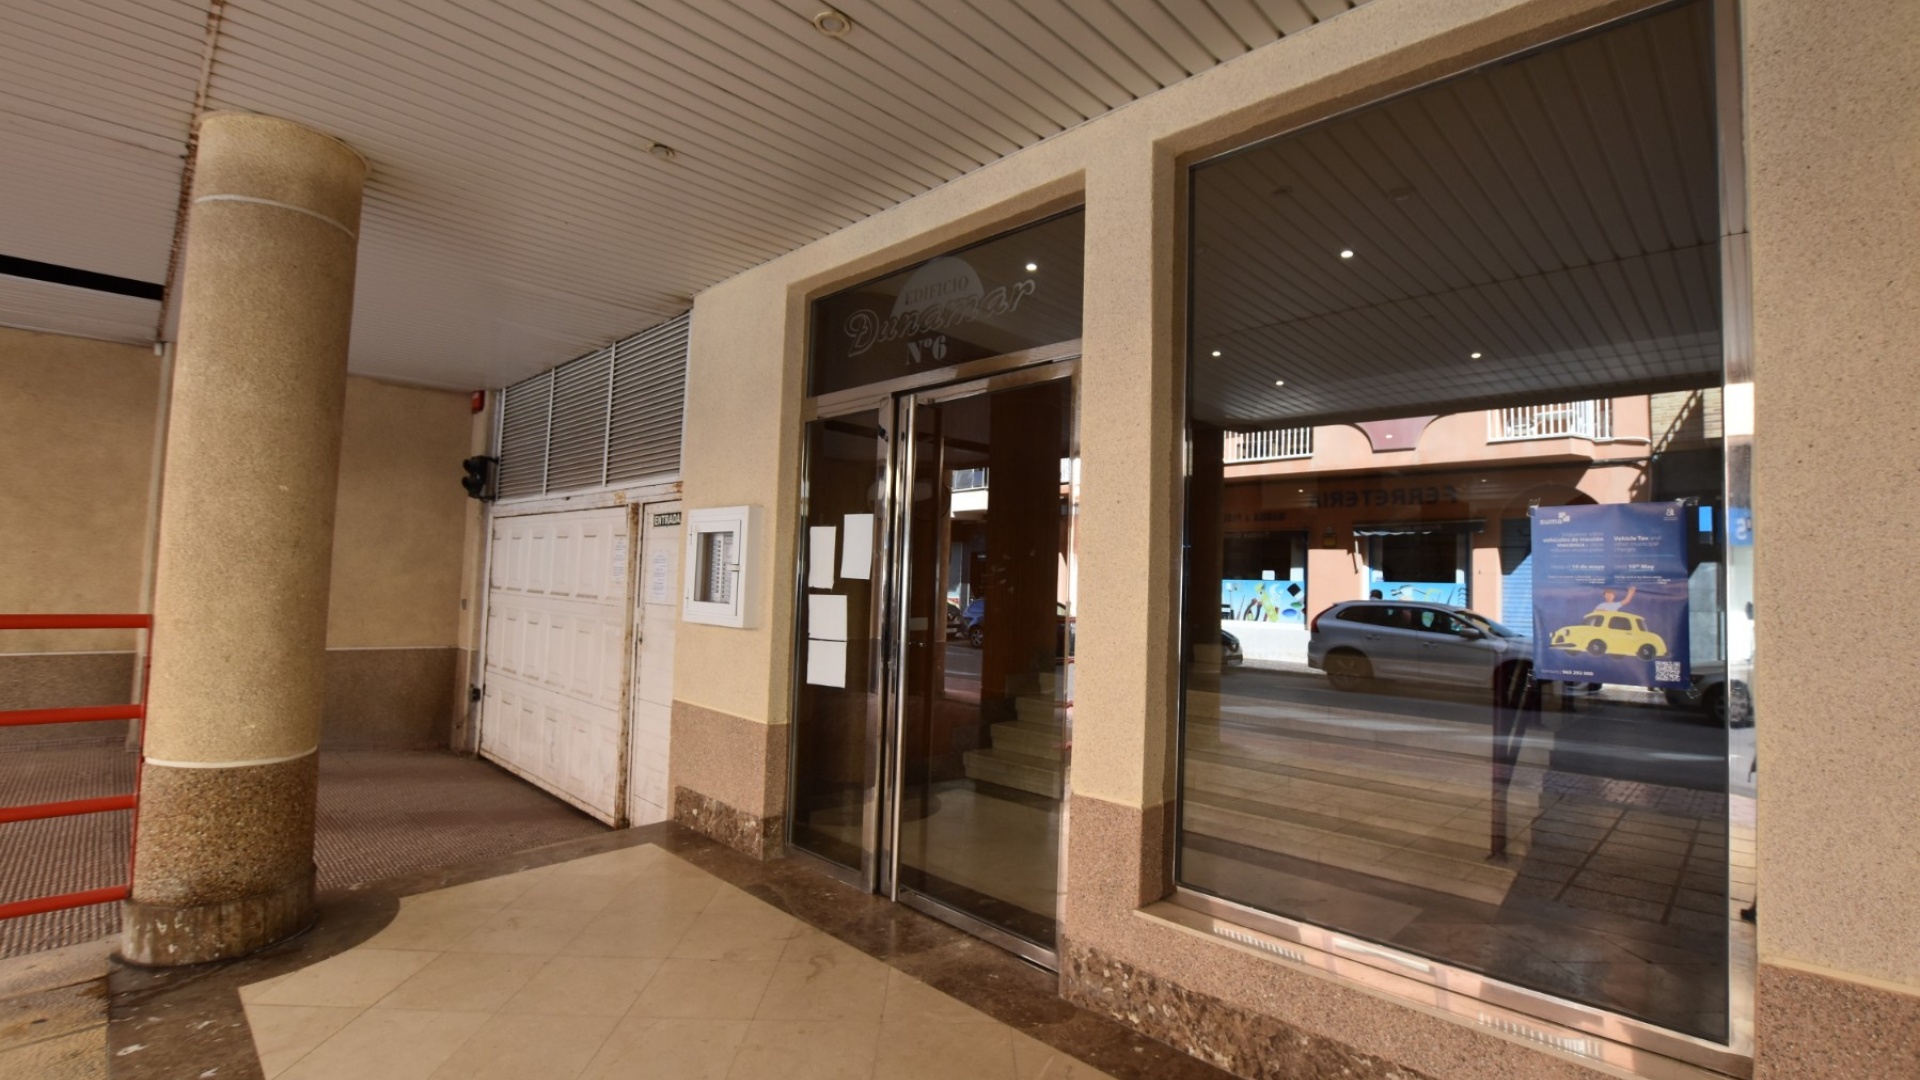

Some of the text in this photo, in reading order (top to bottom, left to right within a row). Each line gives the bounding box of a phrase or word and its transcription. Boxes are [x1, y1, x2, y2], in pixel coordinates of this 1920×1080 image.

[904, 275, 969, 306] EDIFICIO
[844, 279, 1036, 357] Dunamar
[654, 513, 681, 526] ENTRADA
[1539, 517, 1562, 525] suma
